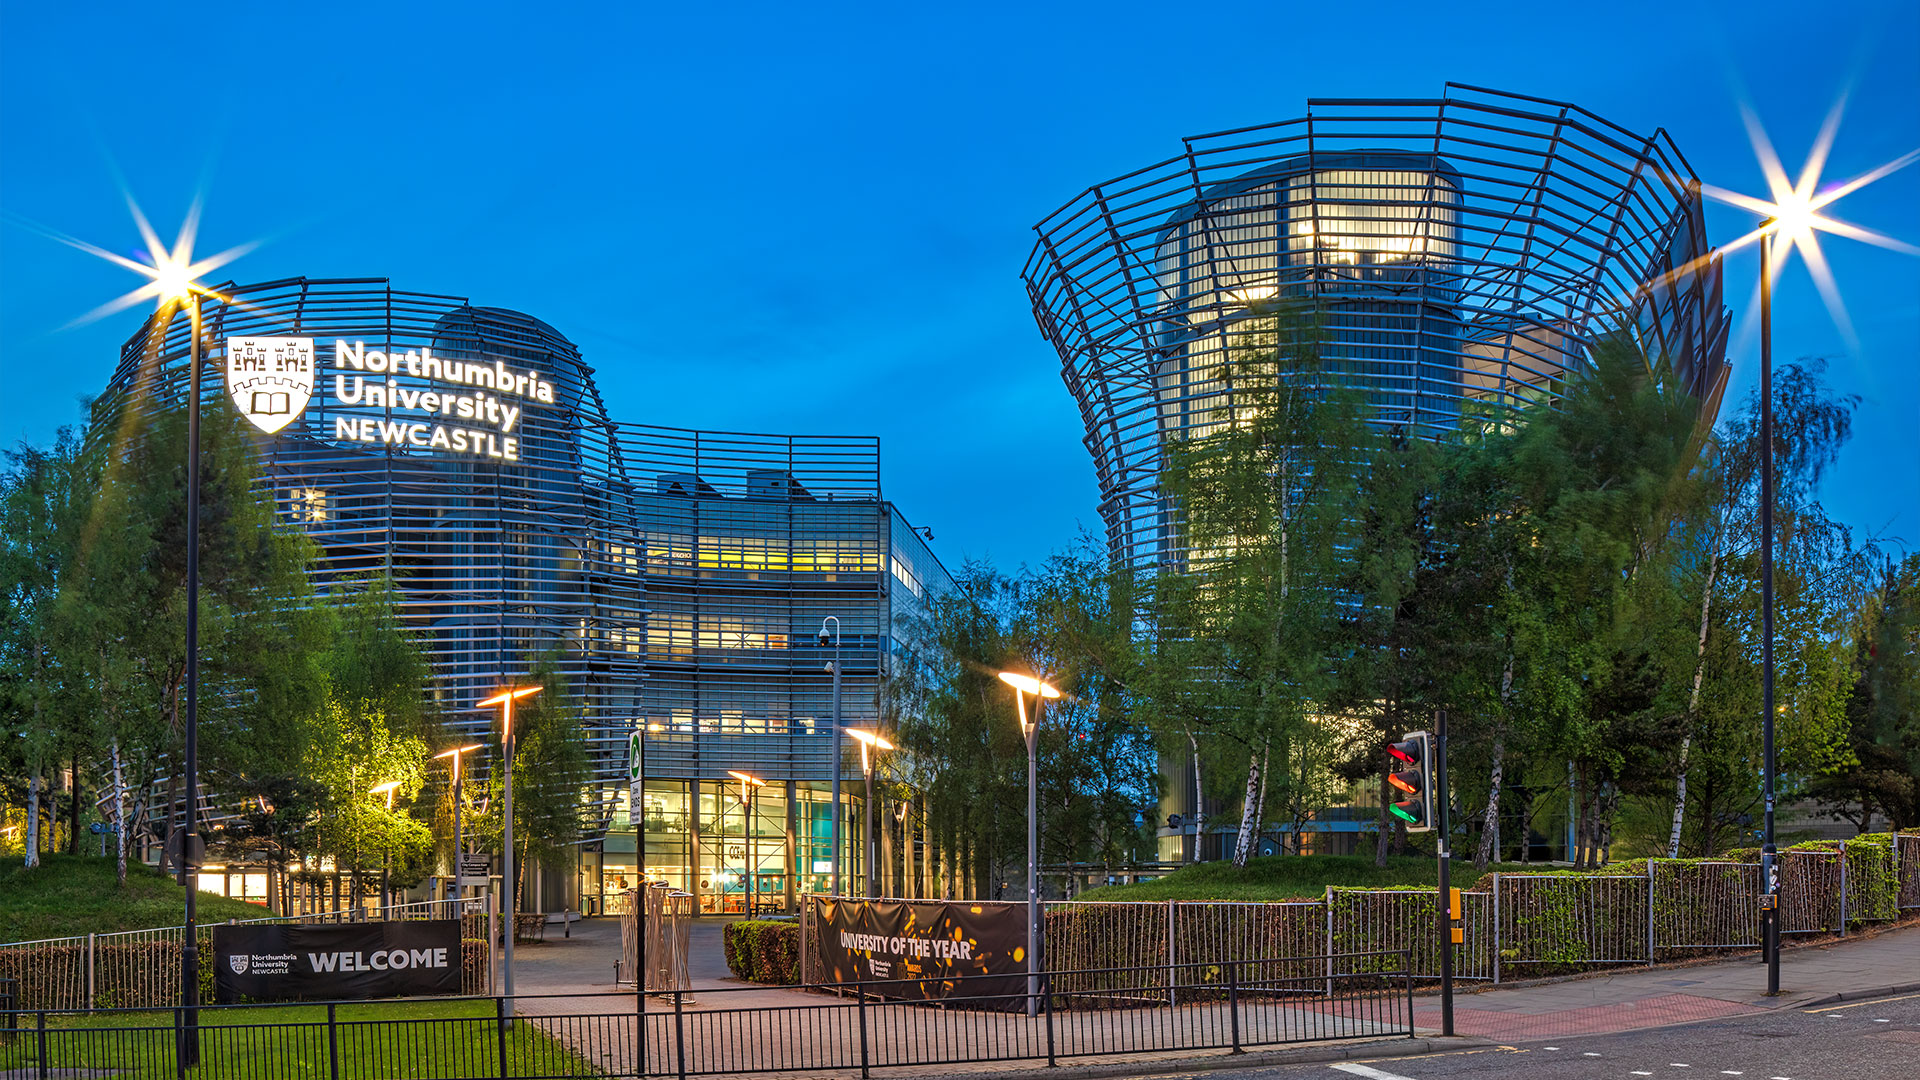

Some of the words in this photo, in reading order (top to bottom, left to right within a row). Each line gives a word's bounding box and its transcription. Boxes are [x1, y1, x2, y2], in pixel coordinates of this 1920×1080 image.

[335, 339, 554, 404] Northumbria
[335, 374, 519, 433] University
[336, 416, 518, 461] NEWCASTLE
[251, 953, 298, 961] Northumbria
[308, 947, 448, 973] WELCOME
[840, 931, 889, 954] UNIVERSITY
[890, 937, 906, 955] OF
[907, 938, 931, 958] THE
[932, 940, 972, 960] YEAR
